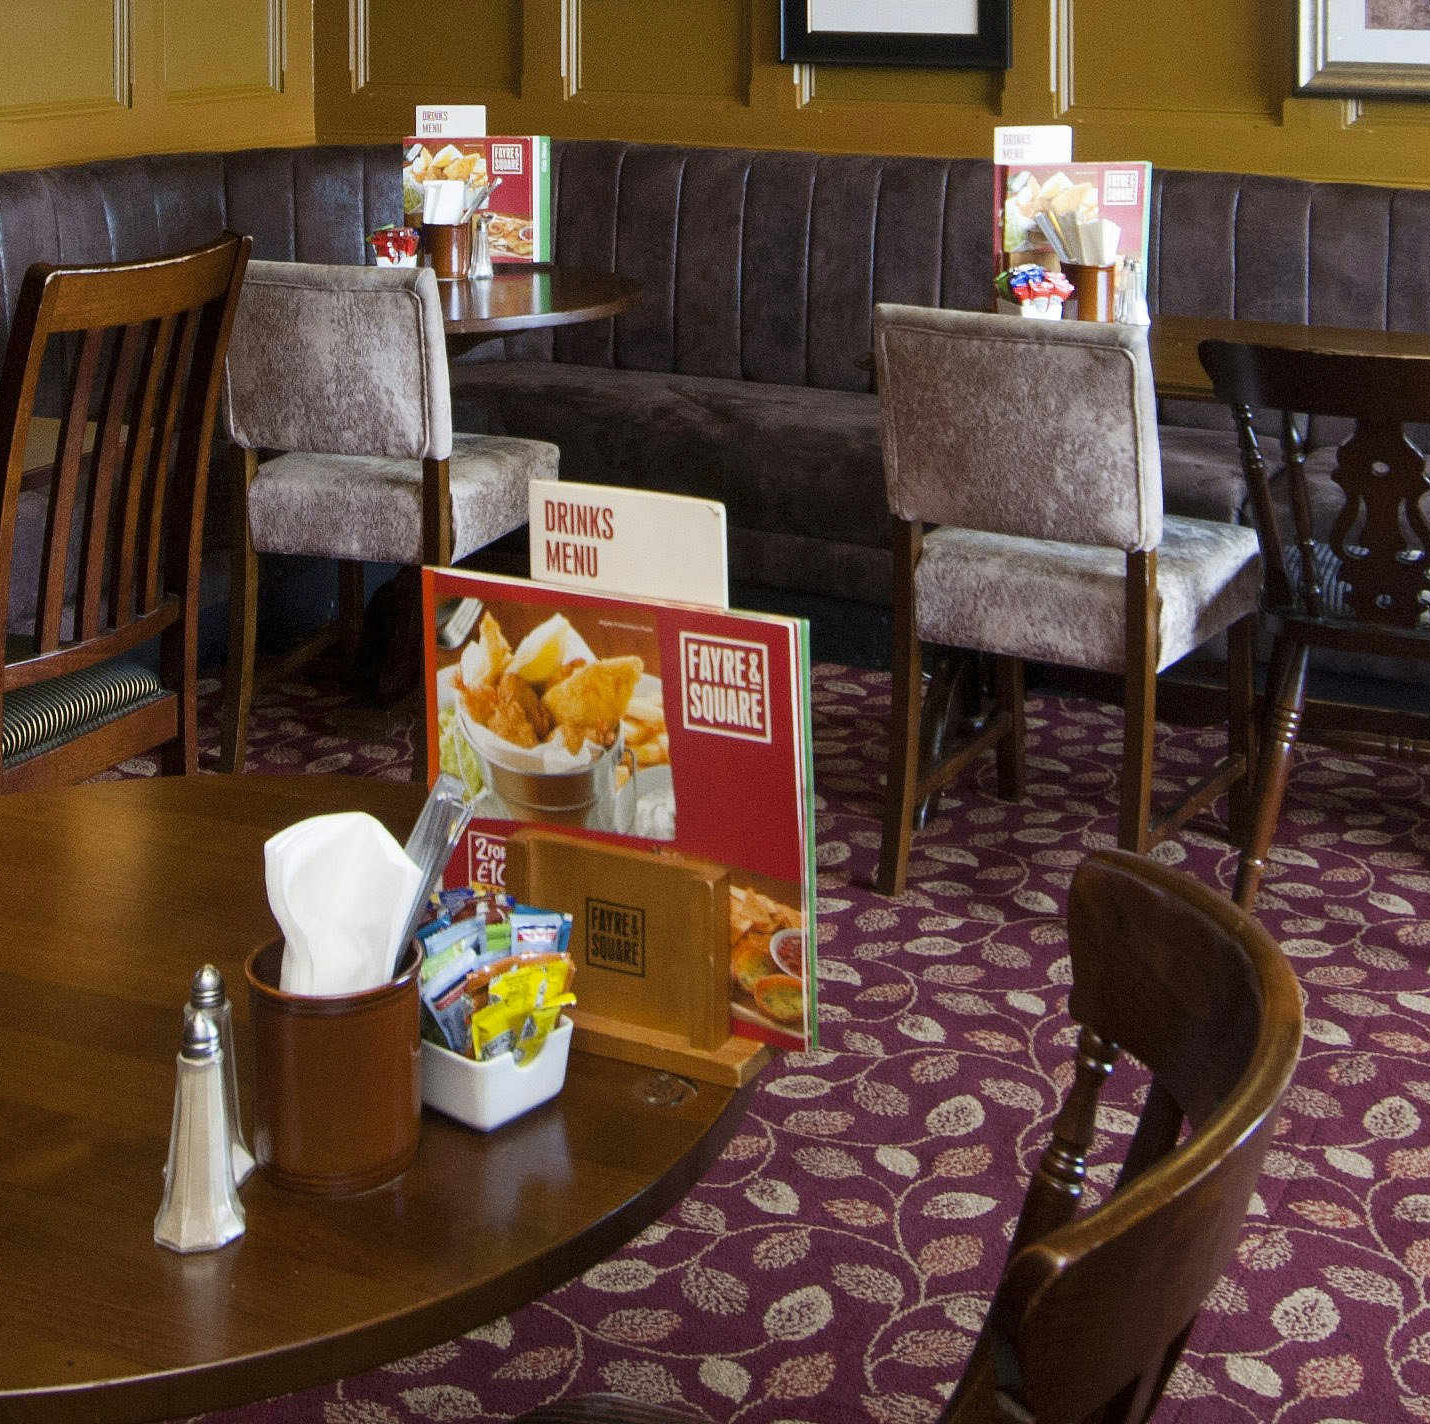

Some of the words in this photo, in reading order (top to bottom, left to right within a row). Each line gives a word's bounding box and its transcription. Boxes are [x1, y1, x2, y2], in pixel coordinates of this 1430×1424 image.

[422, 110, 448, 121] DRINKS
[422, 123, 442, 133] MENU
[544, 499, 614, 541] DRINKS
[545, 539, 598, 578] MENU
[687, 642, 747, 688] FAYRE
[748, 652, 762, 690] &
[689, 681, 763, 730] SQUARE
[592, 906, 630, 937] FAYRE
[631, 915, 640, 940] &
[592, 933, 640, 967] SQUARE
